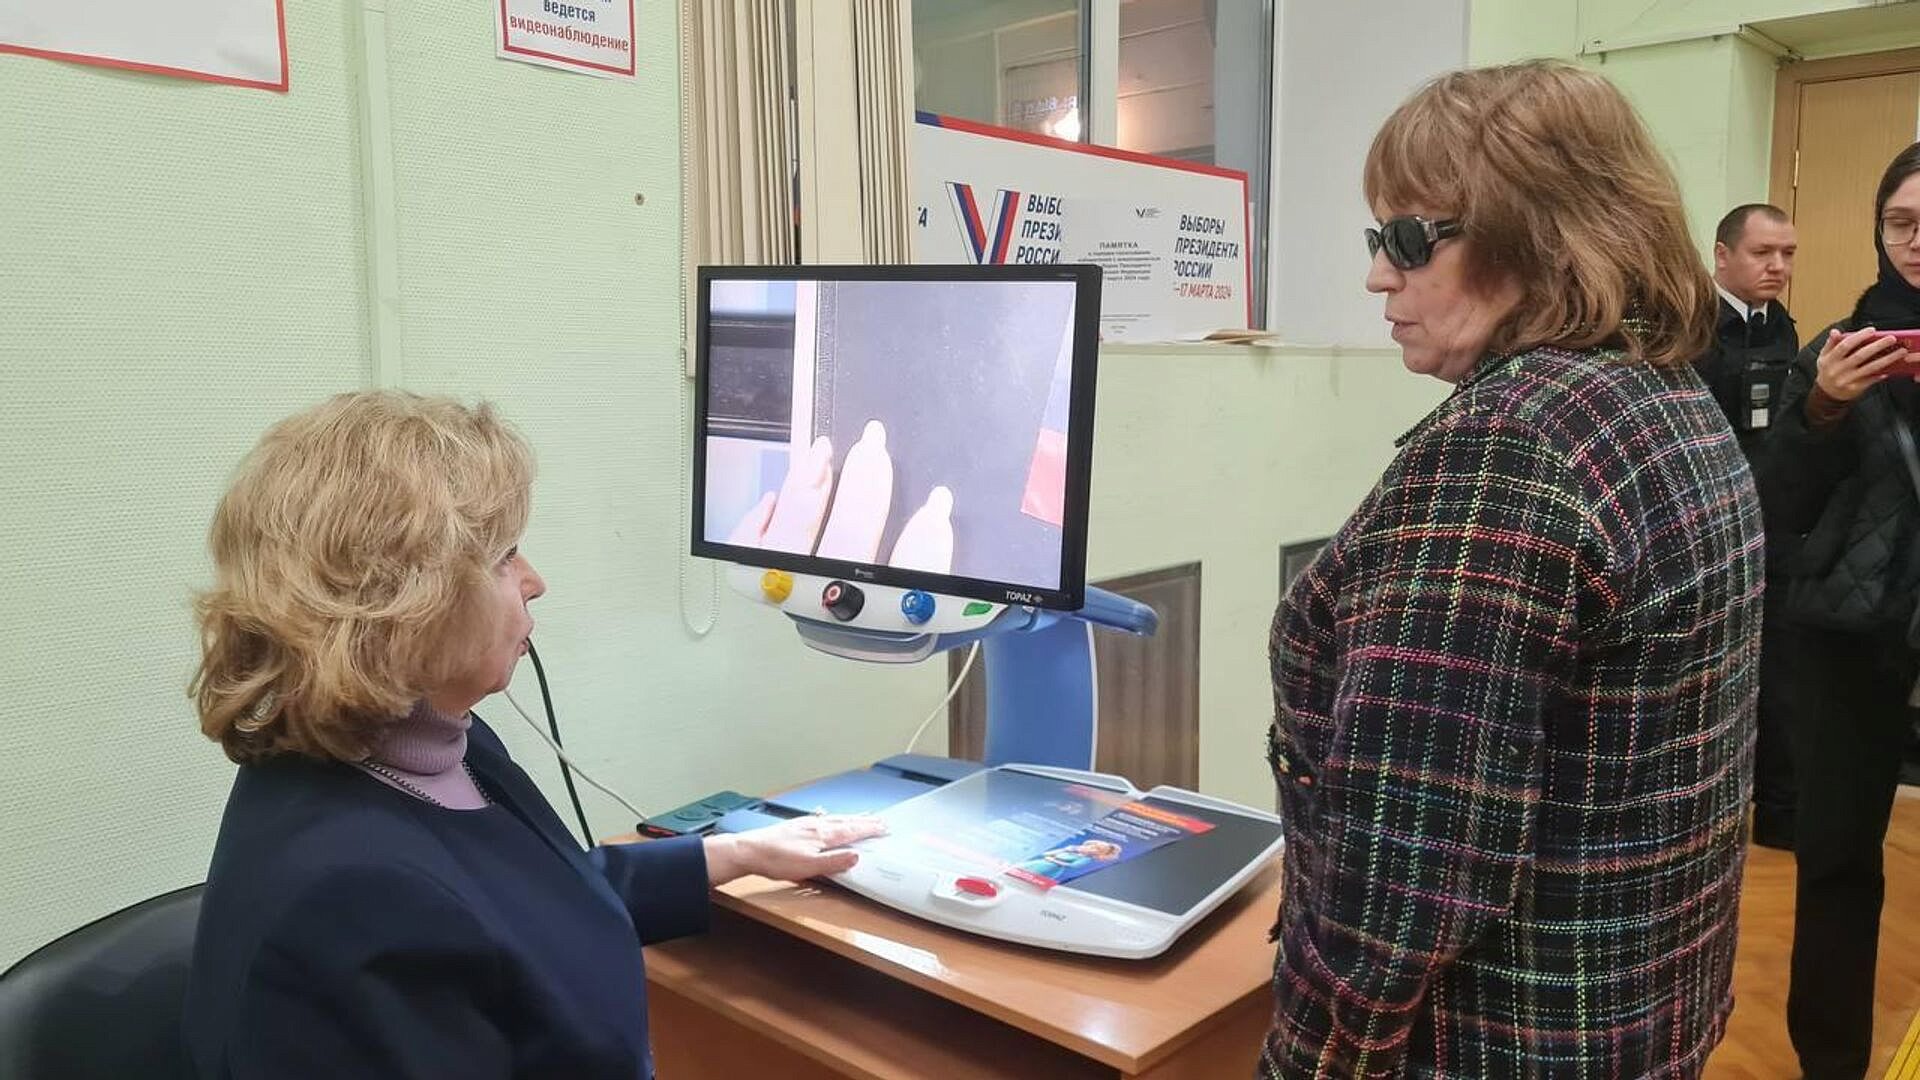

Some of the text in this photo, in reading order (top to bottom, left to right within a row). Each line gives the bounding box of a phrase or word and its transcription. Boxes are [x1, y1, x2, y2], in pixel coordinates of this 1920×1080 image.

[543, 0, 596, 22] ведется
[510, 15, 629, 50] видеонаблюдение
[1179, 214, 1225, 235] ВЫБОРЫ
[1099, 241, 1138, 250] ПАМЯТКА
[1174, 237, 1239, 260] ПРЕЗИДЕНТА
[1189, 283, 1213, 298] МАРТА
[1213, 285, 1232, 300] 2024
[1006, 590, 1032, 603] TOPAZ
